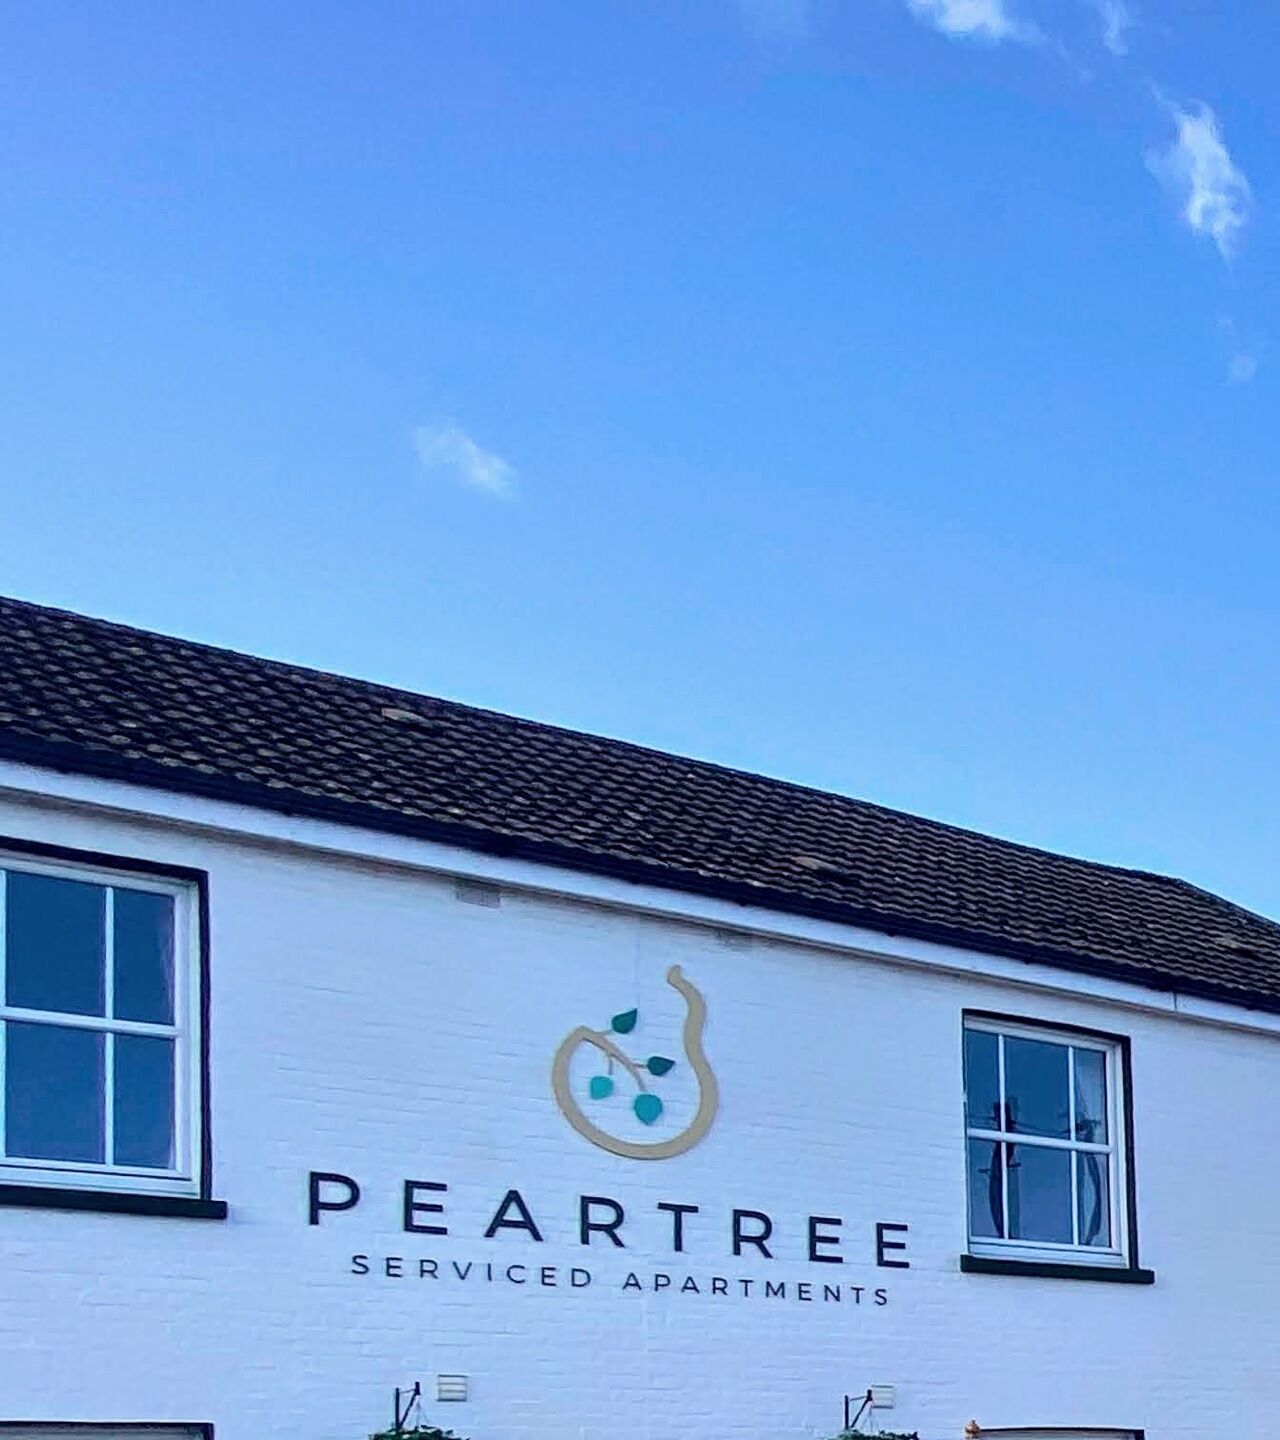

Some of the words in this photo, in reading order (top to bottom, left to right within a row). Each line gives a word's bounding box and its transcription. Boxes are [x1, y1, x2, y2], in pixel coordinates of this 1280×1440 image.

[308, 1170, 911, 1269] PEARTREE
[350, 1254, 592, 1288] SERVICED
[621, 1272, 889, 1307] APARTMENTS
